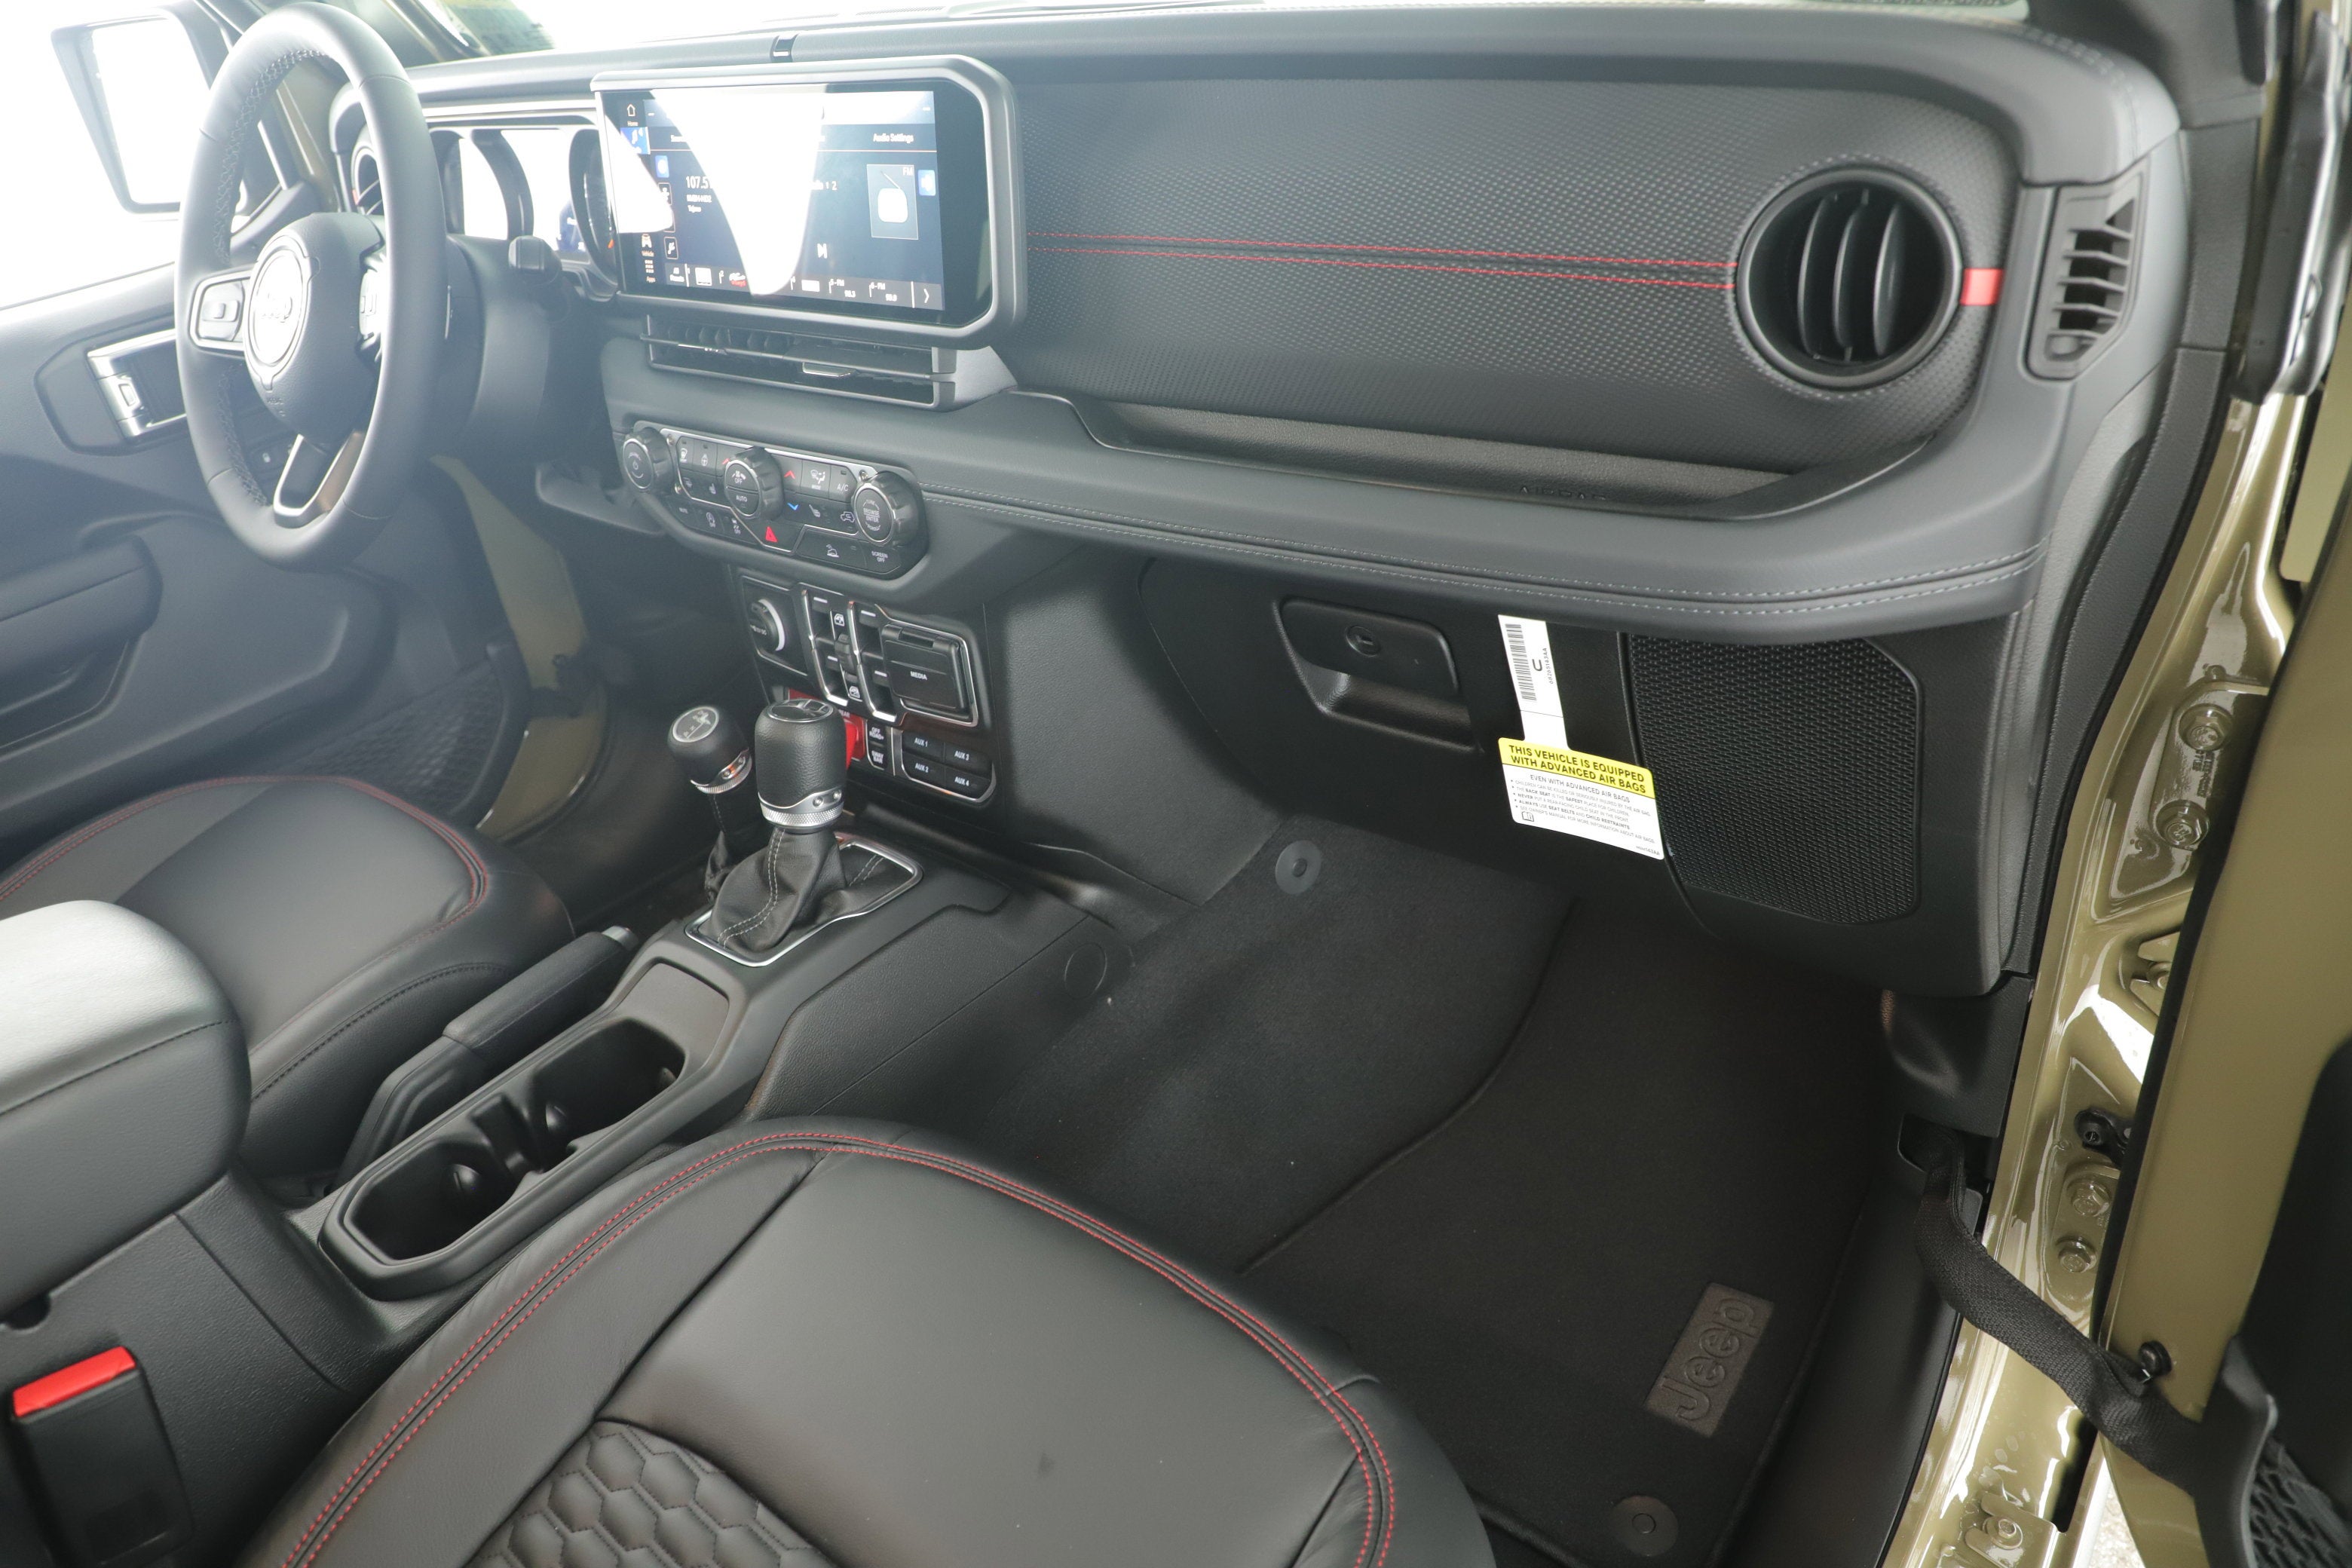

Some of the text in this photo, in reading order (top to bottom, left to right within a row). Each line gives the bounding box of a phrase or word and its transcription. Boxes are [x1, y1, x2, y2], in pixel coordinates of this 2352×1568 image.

[873, 133, 914, 143] Audio Settings
[903, 167, 913, 176] FM
[837, 483, 849, 492] A/C
[863, 507, 880, 516] BROWSE
[865, 515, 879, 523] ENTER
[1532, 658, 1543, 672] U
[910, 671, 928, 681] MEDIA
[914, 737, 925, 746] AUX
[954, 751, 964, 759] AUX
[915, 763, 925, 771] AUX
[1508, 745, 1644, 782] THIS VEHICLE IS EQUIPPED
[1511, 755, 1646, 793] WITH ADVANCED AIR BAGS
[954, 776, 965, 786] AUX
[1566, 782, 1600, 795] ADVANCED
[1613, 794, 1630, 803] BAGS
[1660, 1297, 1761, 1421] Jeep
